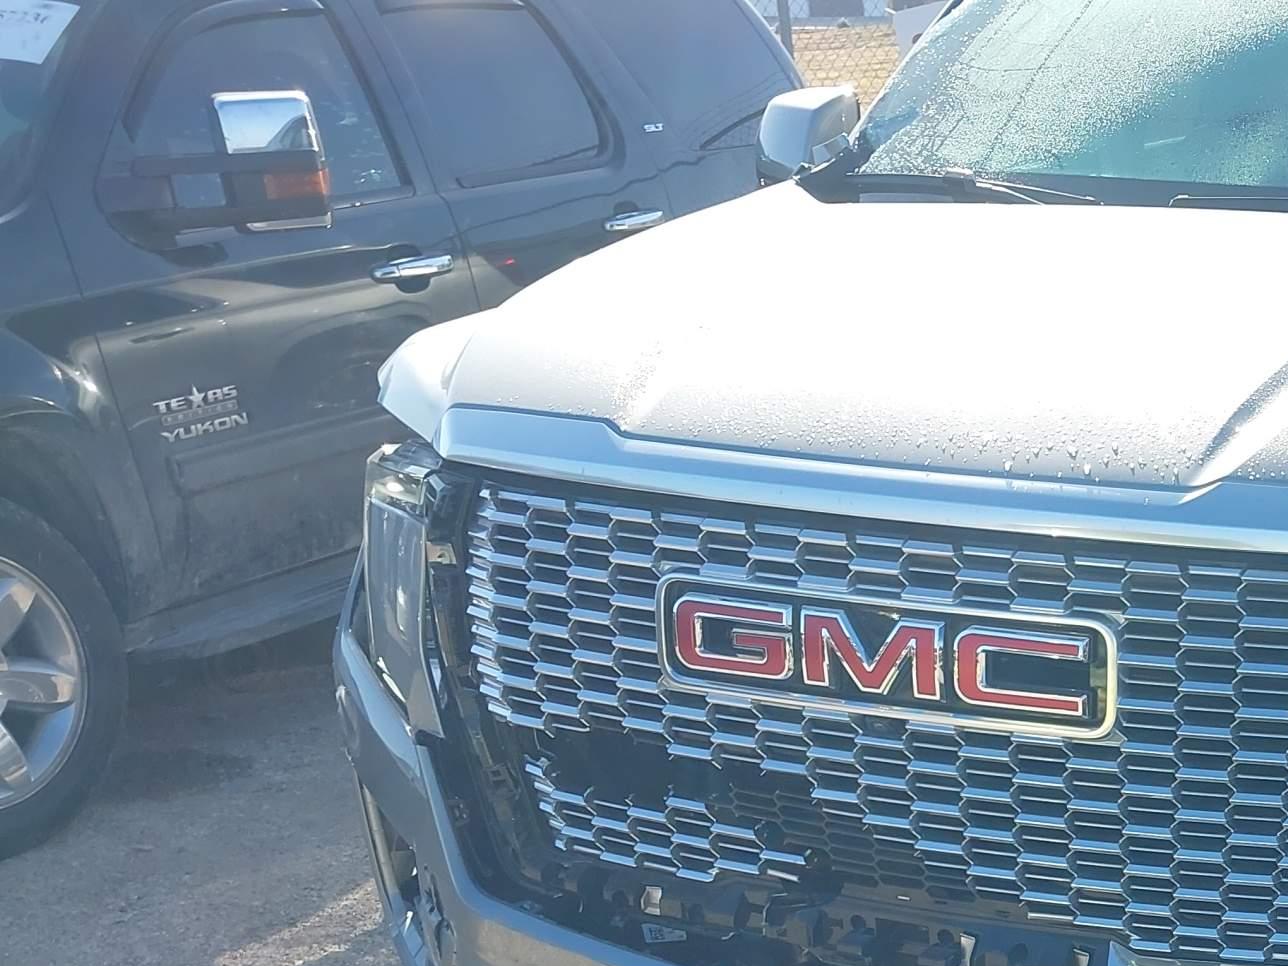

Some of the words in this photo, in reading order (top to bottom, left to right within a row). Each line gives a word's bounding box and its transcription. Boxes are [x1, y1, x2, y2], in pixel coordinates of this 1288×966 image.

[643, 122, 664, 133] SLT
[152, 384, 238, 414] TEXAS
[160, 411, 249, 443] YUKON
[673, 592, 1090, 717] GMC
